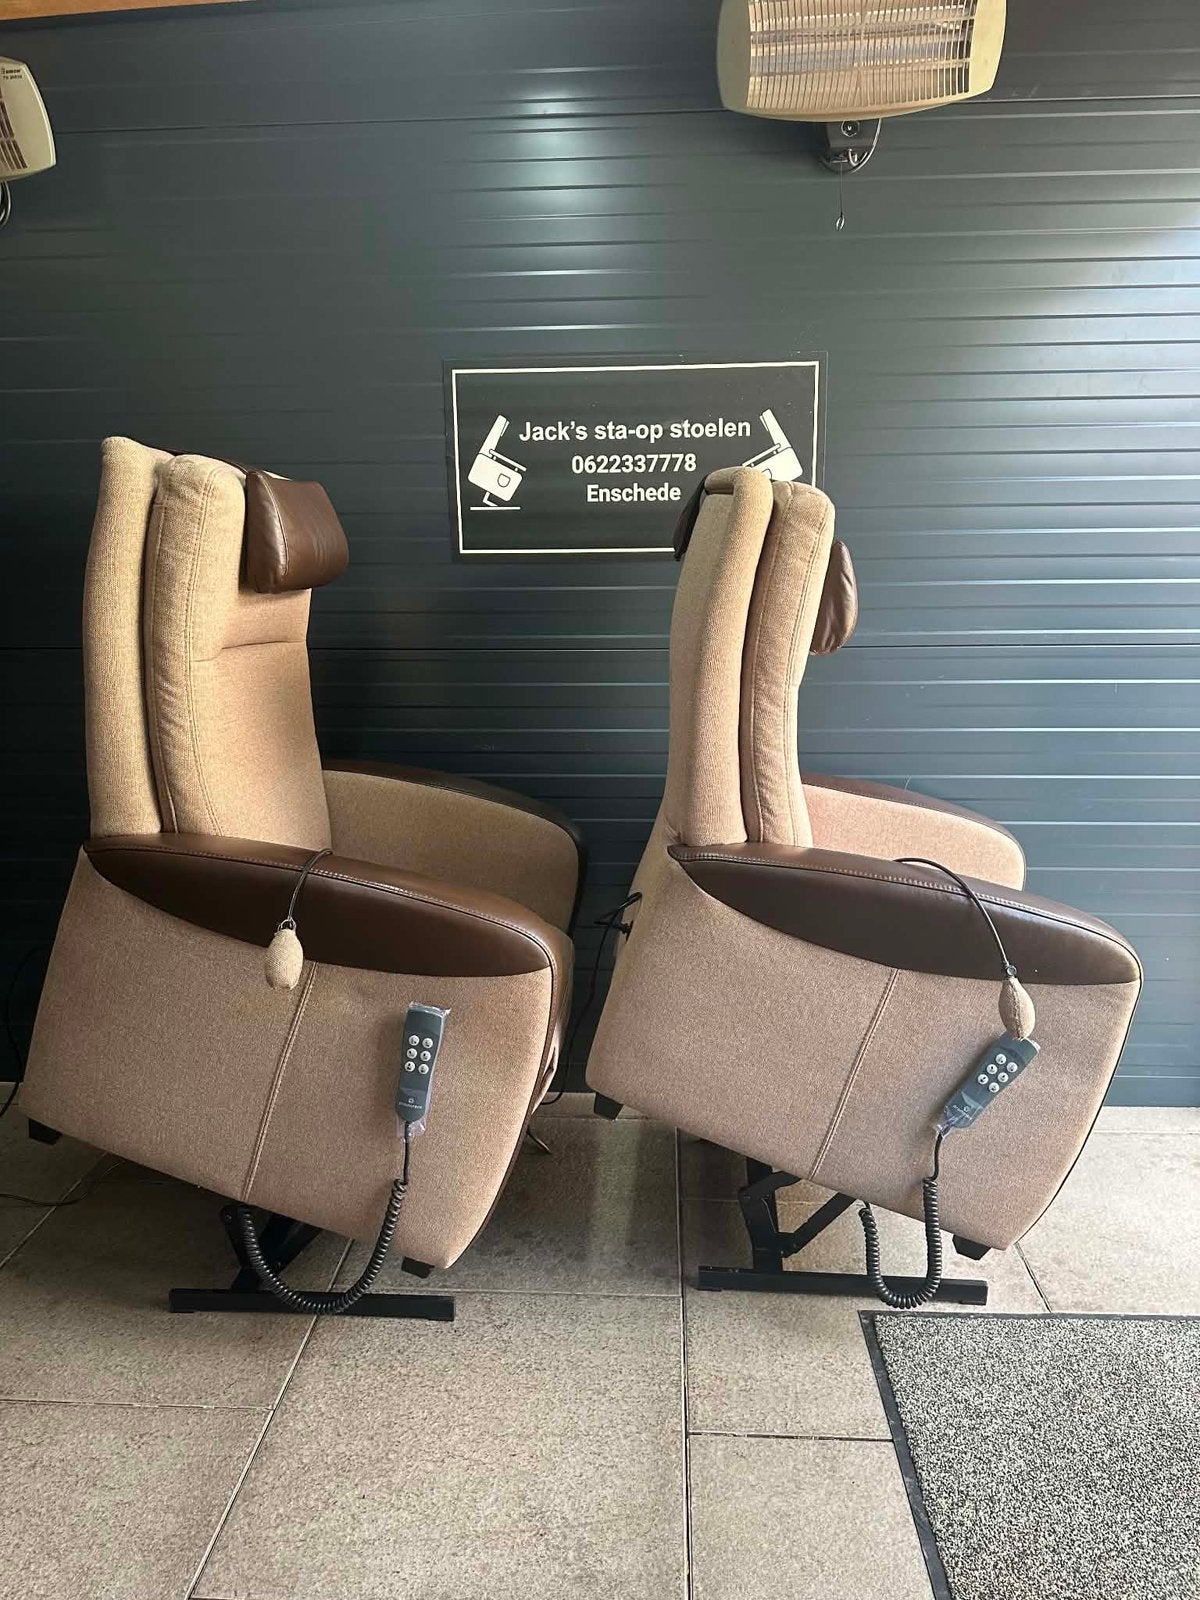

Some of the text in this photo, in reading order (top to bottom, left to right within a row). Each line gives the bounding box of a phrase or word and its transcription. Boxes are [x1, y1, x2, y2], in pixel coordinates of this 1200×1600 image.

[518, 417, 751, 444] Jack’s sta-op stoelen
[571, 452, 697, 474] 0622337778
[586, 482, 682, 503] Enschede
